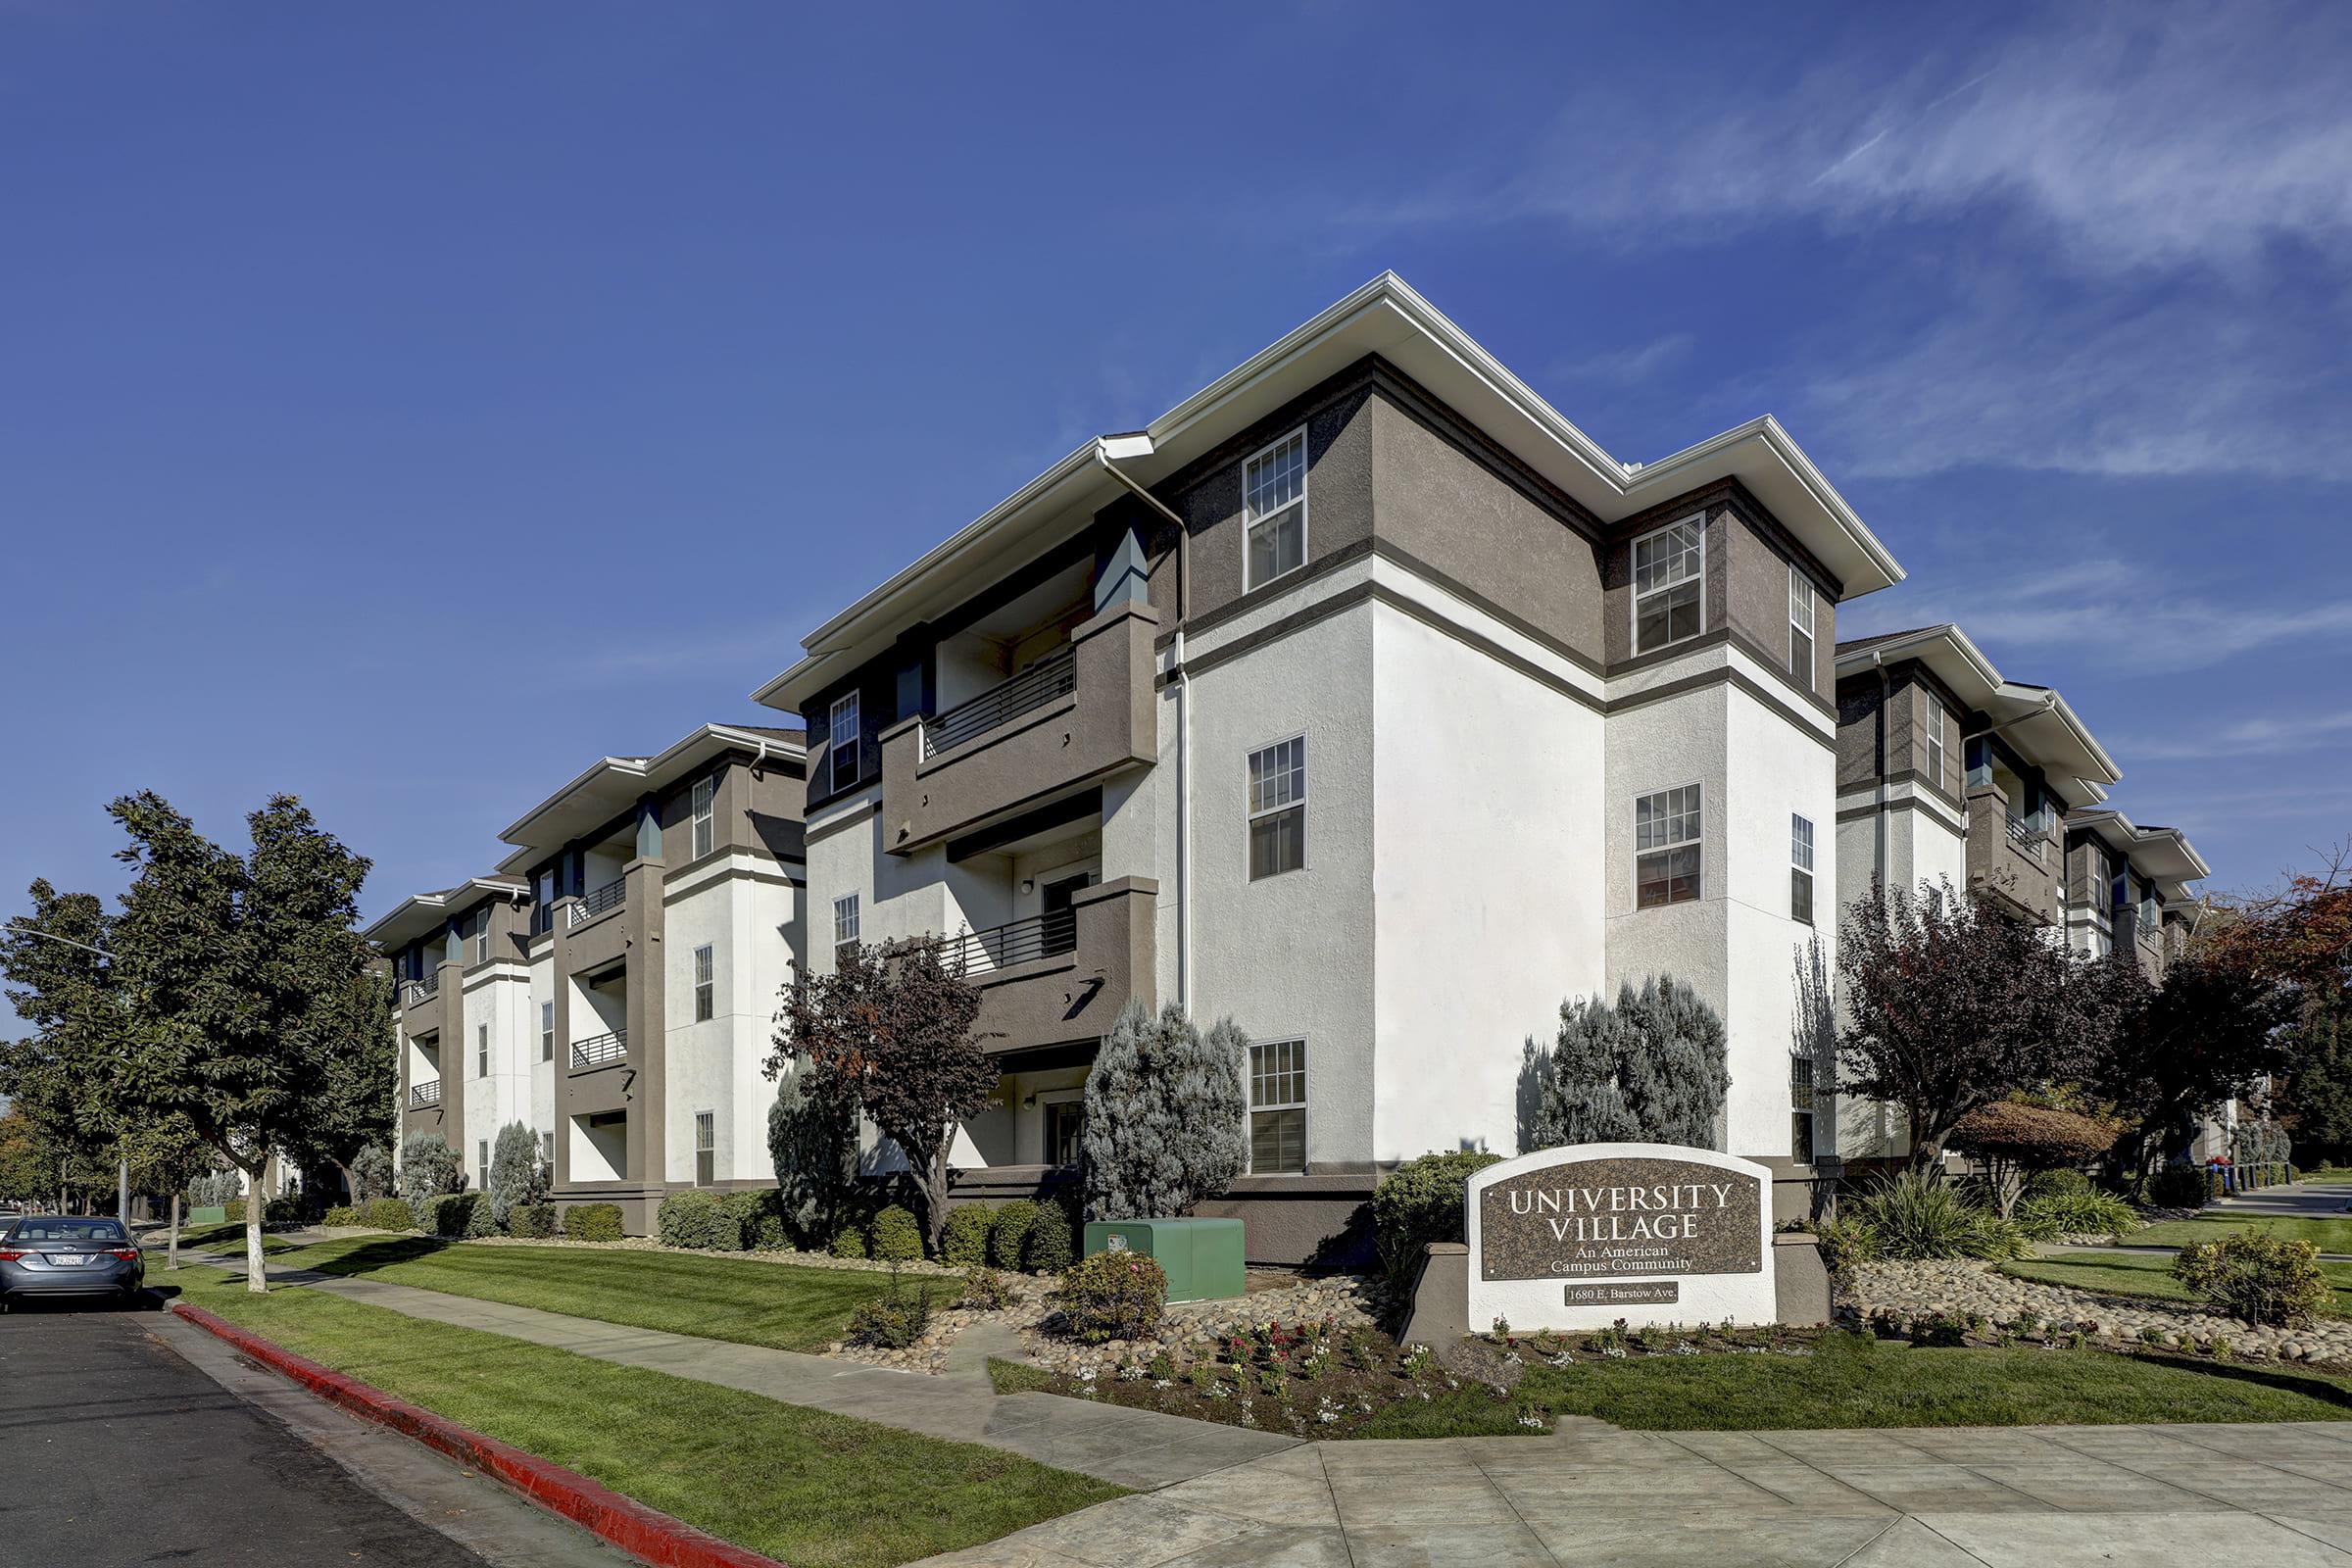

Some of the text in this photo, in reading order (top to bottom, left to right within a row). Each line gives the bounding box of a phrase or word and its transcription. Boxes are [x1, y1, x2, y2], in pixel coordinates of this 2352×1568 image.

[1509, 1183, 1734, 1214] UNIVERSITY
[1547, 1214, 1698, 1242] VILLAGE
[1577, 1246, 1669, 1258] An American
[1551, 1257, 1693, 1274] Campus Community
[1570, 1288, 1677, 1299] 1680 E. Barstow Ave.
